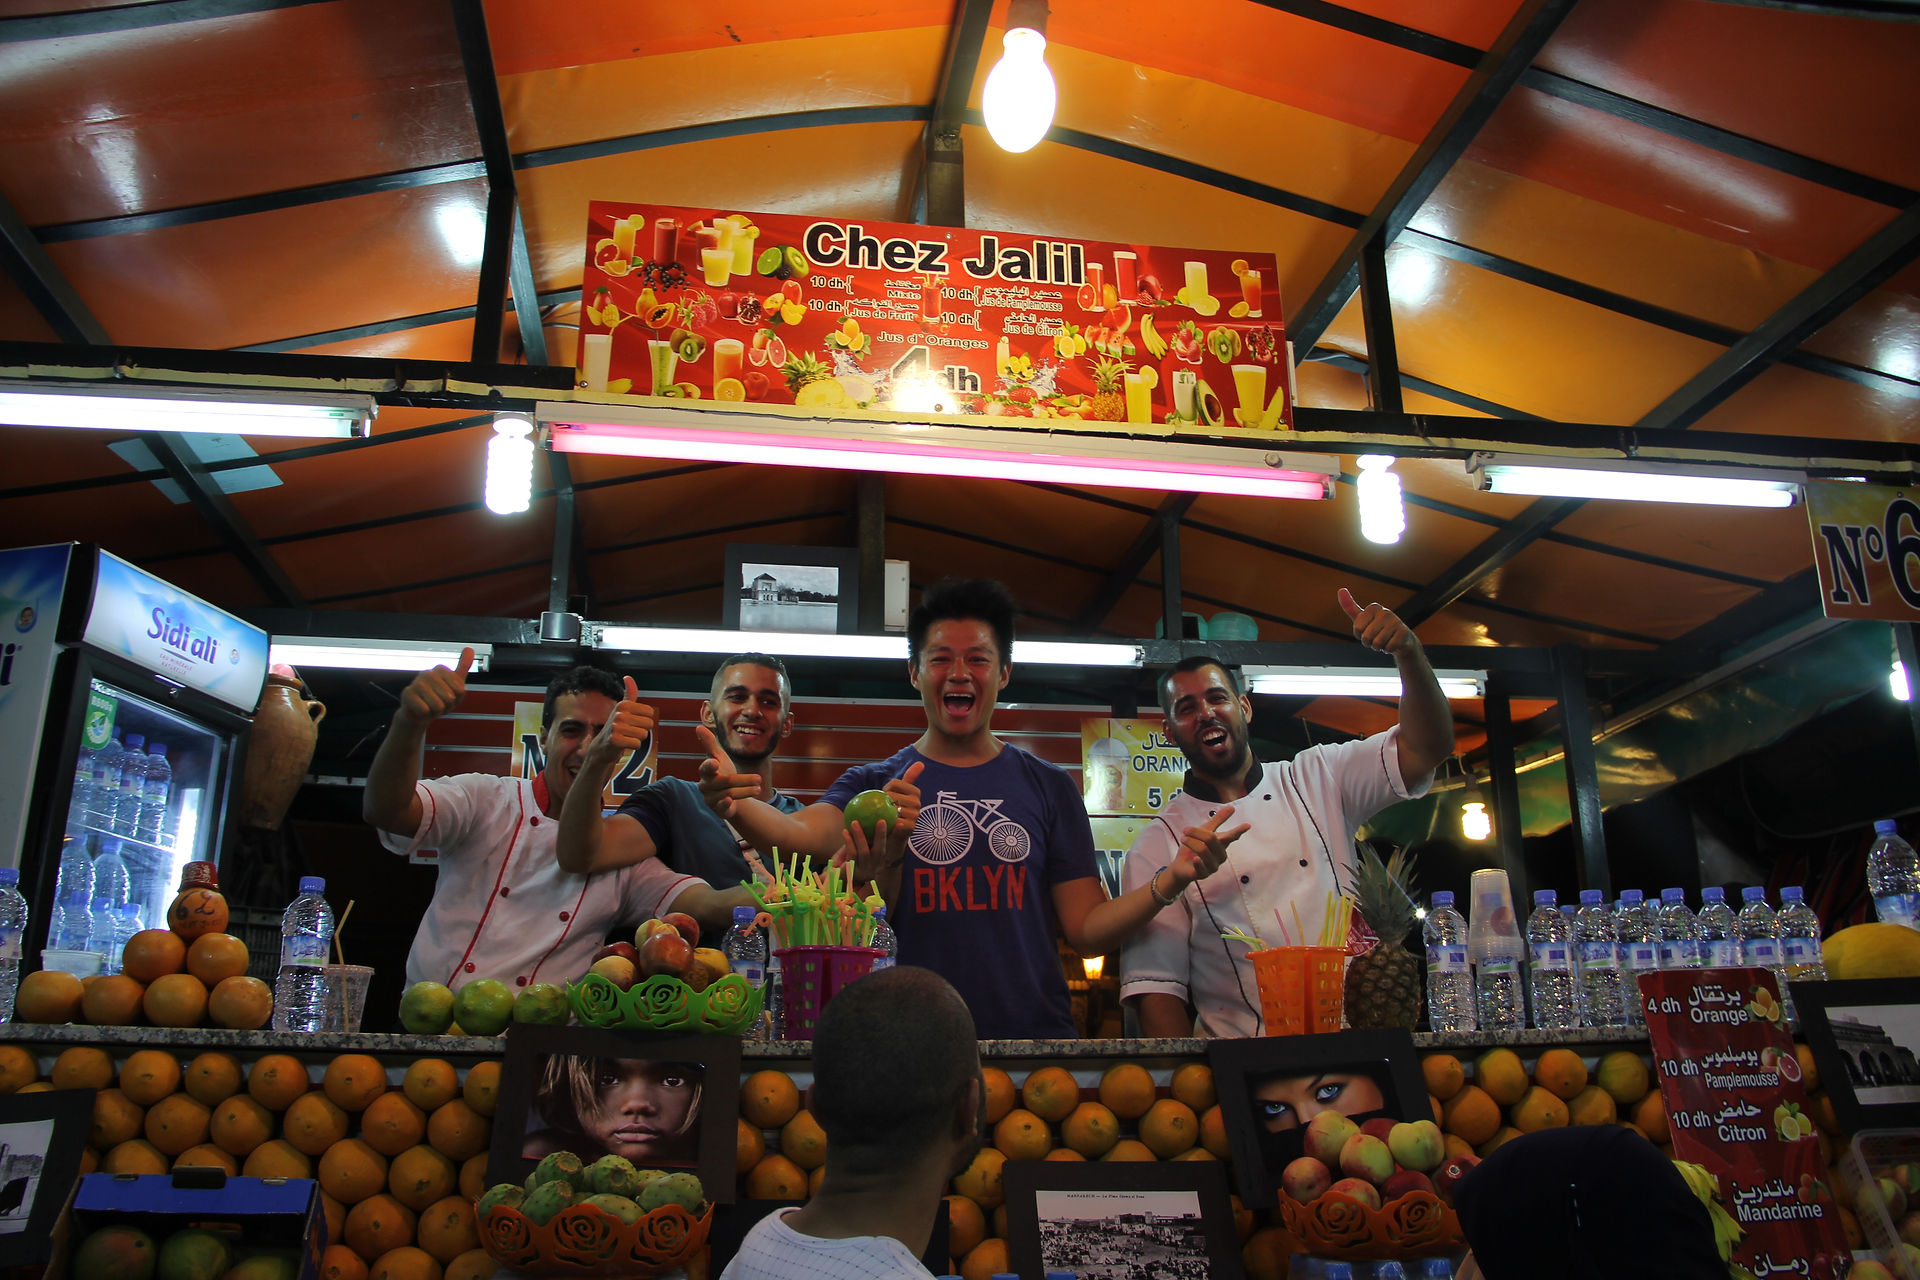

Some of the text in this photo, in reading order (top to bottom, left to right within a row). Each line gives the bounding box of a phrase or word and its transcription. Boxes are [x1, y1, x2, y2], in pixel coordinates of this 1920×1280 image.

[803, 222, 1085, 286] Chez Jalil
[811, 276, 844, 289] 10 dh
[941, 288, 973, 300] 10 dh
[809, 300, 841, 312] 10 dh
[981, 295, 1063, 312] Jus de Pamplemousse
[851, 308, 871, 317] Jus
[872, 310, 887, 318] de
[941, 312, 973, 325] 10 dh
[877, 331, 904, 343] Jus
[1002, 323, 1064, 337] Jus de Citron
[936, 365, 981, 394] dh
[147, 607, 217, 664] Sidi ali
[1132, 754, 1190, 773] ORAN
[1147, 786, 1163, 809] 5
[914, 865, 1026, 913] BKLYN
[1688, 985, 1741, 1006] برتقال
[1647, 997, 1681, 1013] 4 dh
[1690, 1007, 1748, 1025] Orange
[1661, 1059, 1699, 1076] 10 dh
[1704, 1072, 1779, 1091] Pamplemousse
[1673, 1111, 1711, 1128] 10 dh
[1714, 1099, 1761, 1124] حامض
[1718, 1124, 1767, 1142] Citron
[1732, 1179, 1794, 1204] ماندرين
[1736, 1202, 1822, 1222] Mandarine
[1754, 1252, 1810, 1277] رمان
